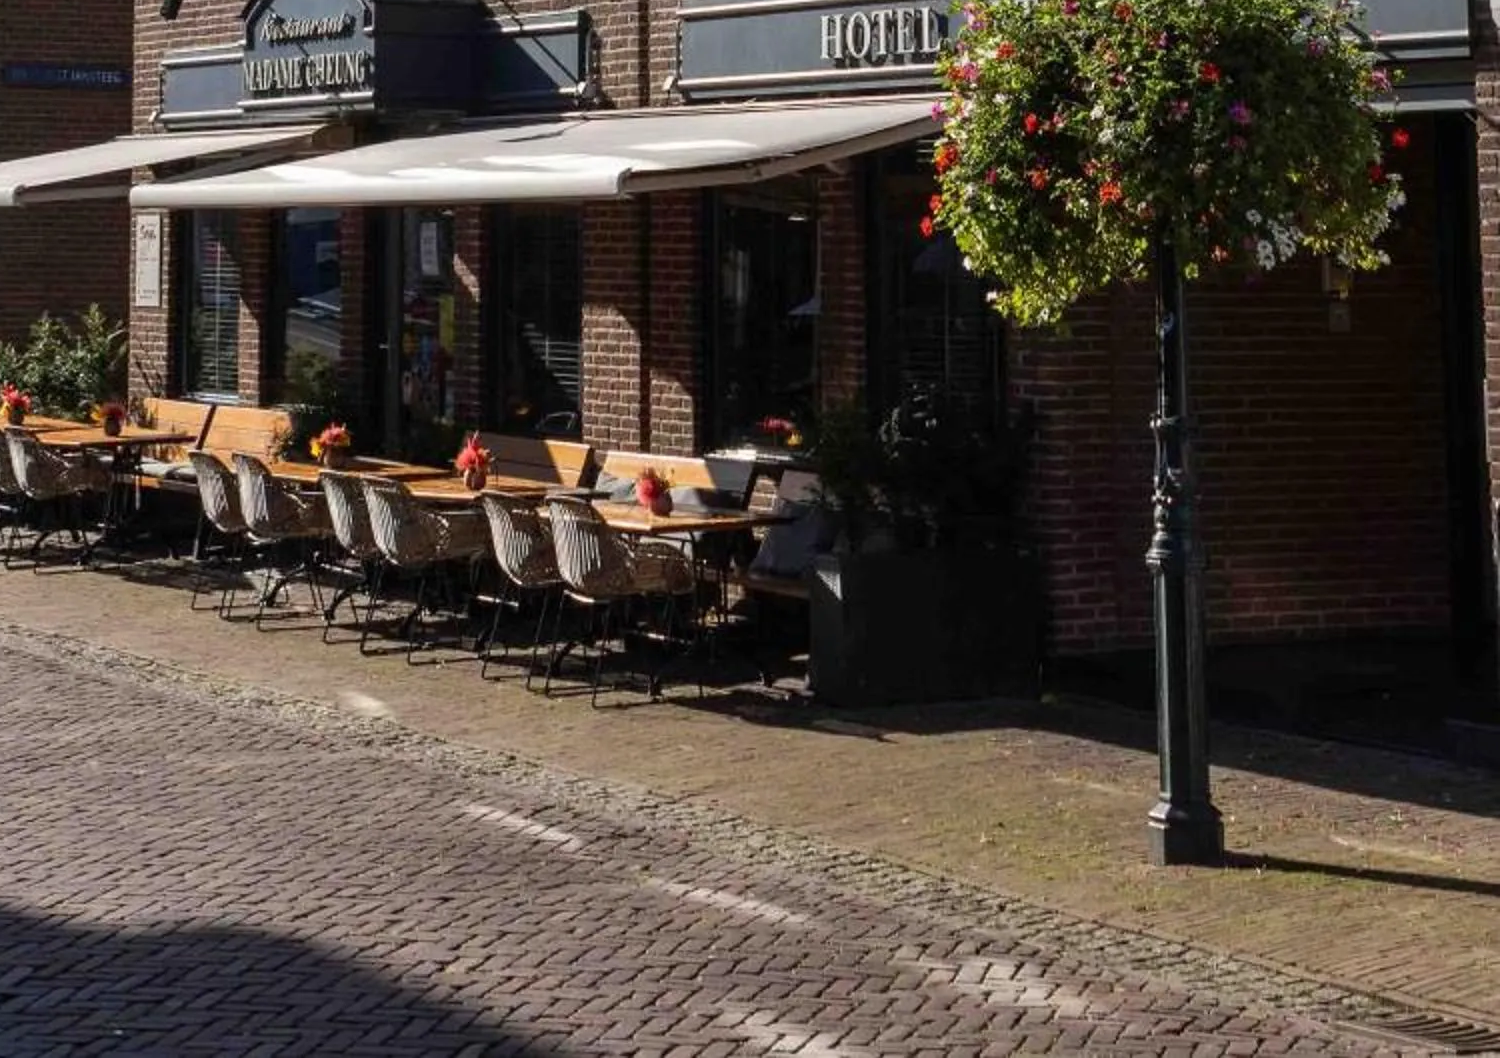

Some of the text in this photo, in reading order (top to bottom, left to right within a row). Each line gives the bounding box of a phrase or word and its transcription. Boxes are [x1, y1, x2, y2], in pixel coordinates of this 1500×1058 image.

[259, 12, 350, 42] Restaurant
[819, 6, 941, 60] HOTEL
[243, 50, 366, 92] MADAME CHEUNG
